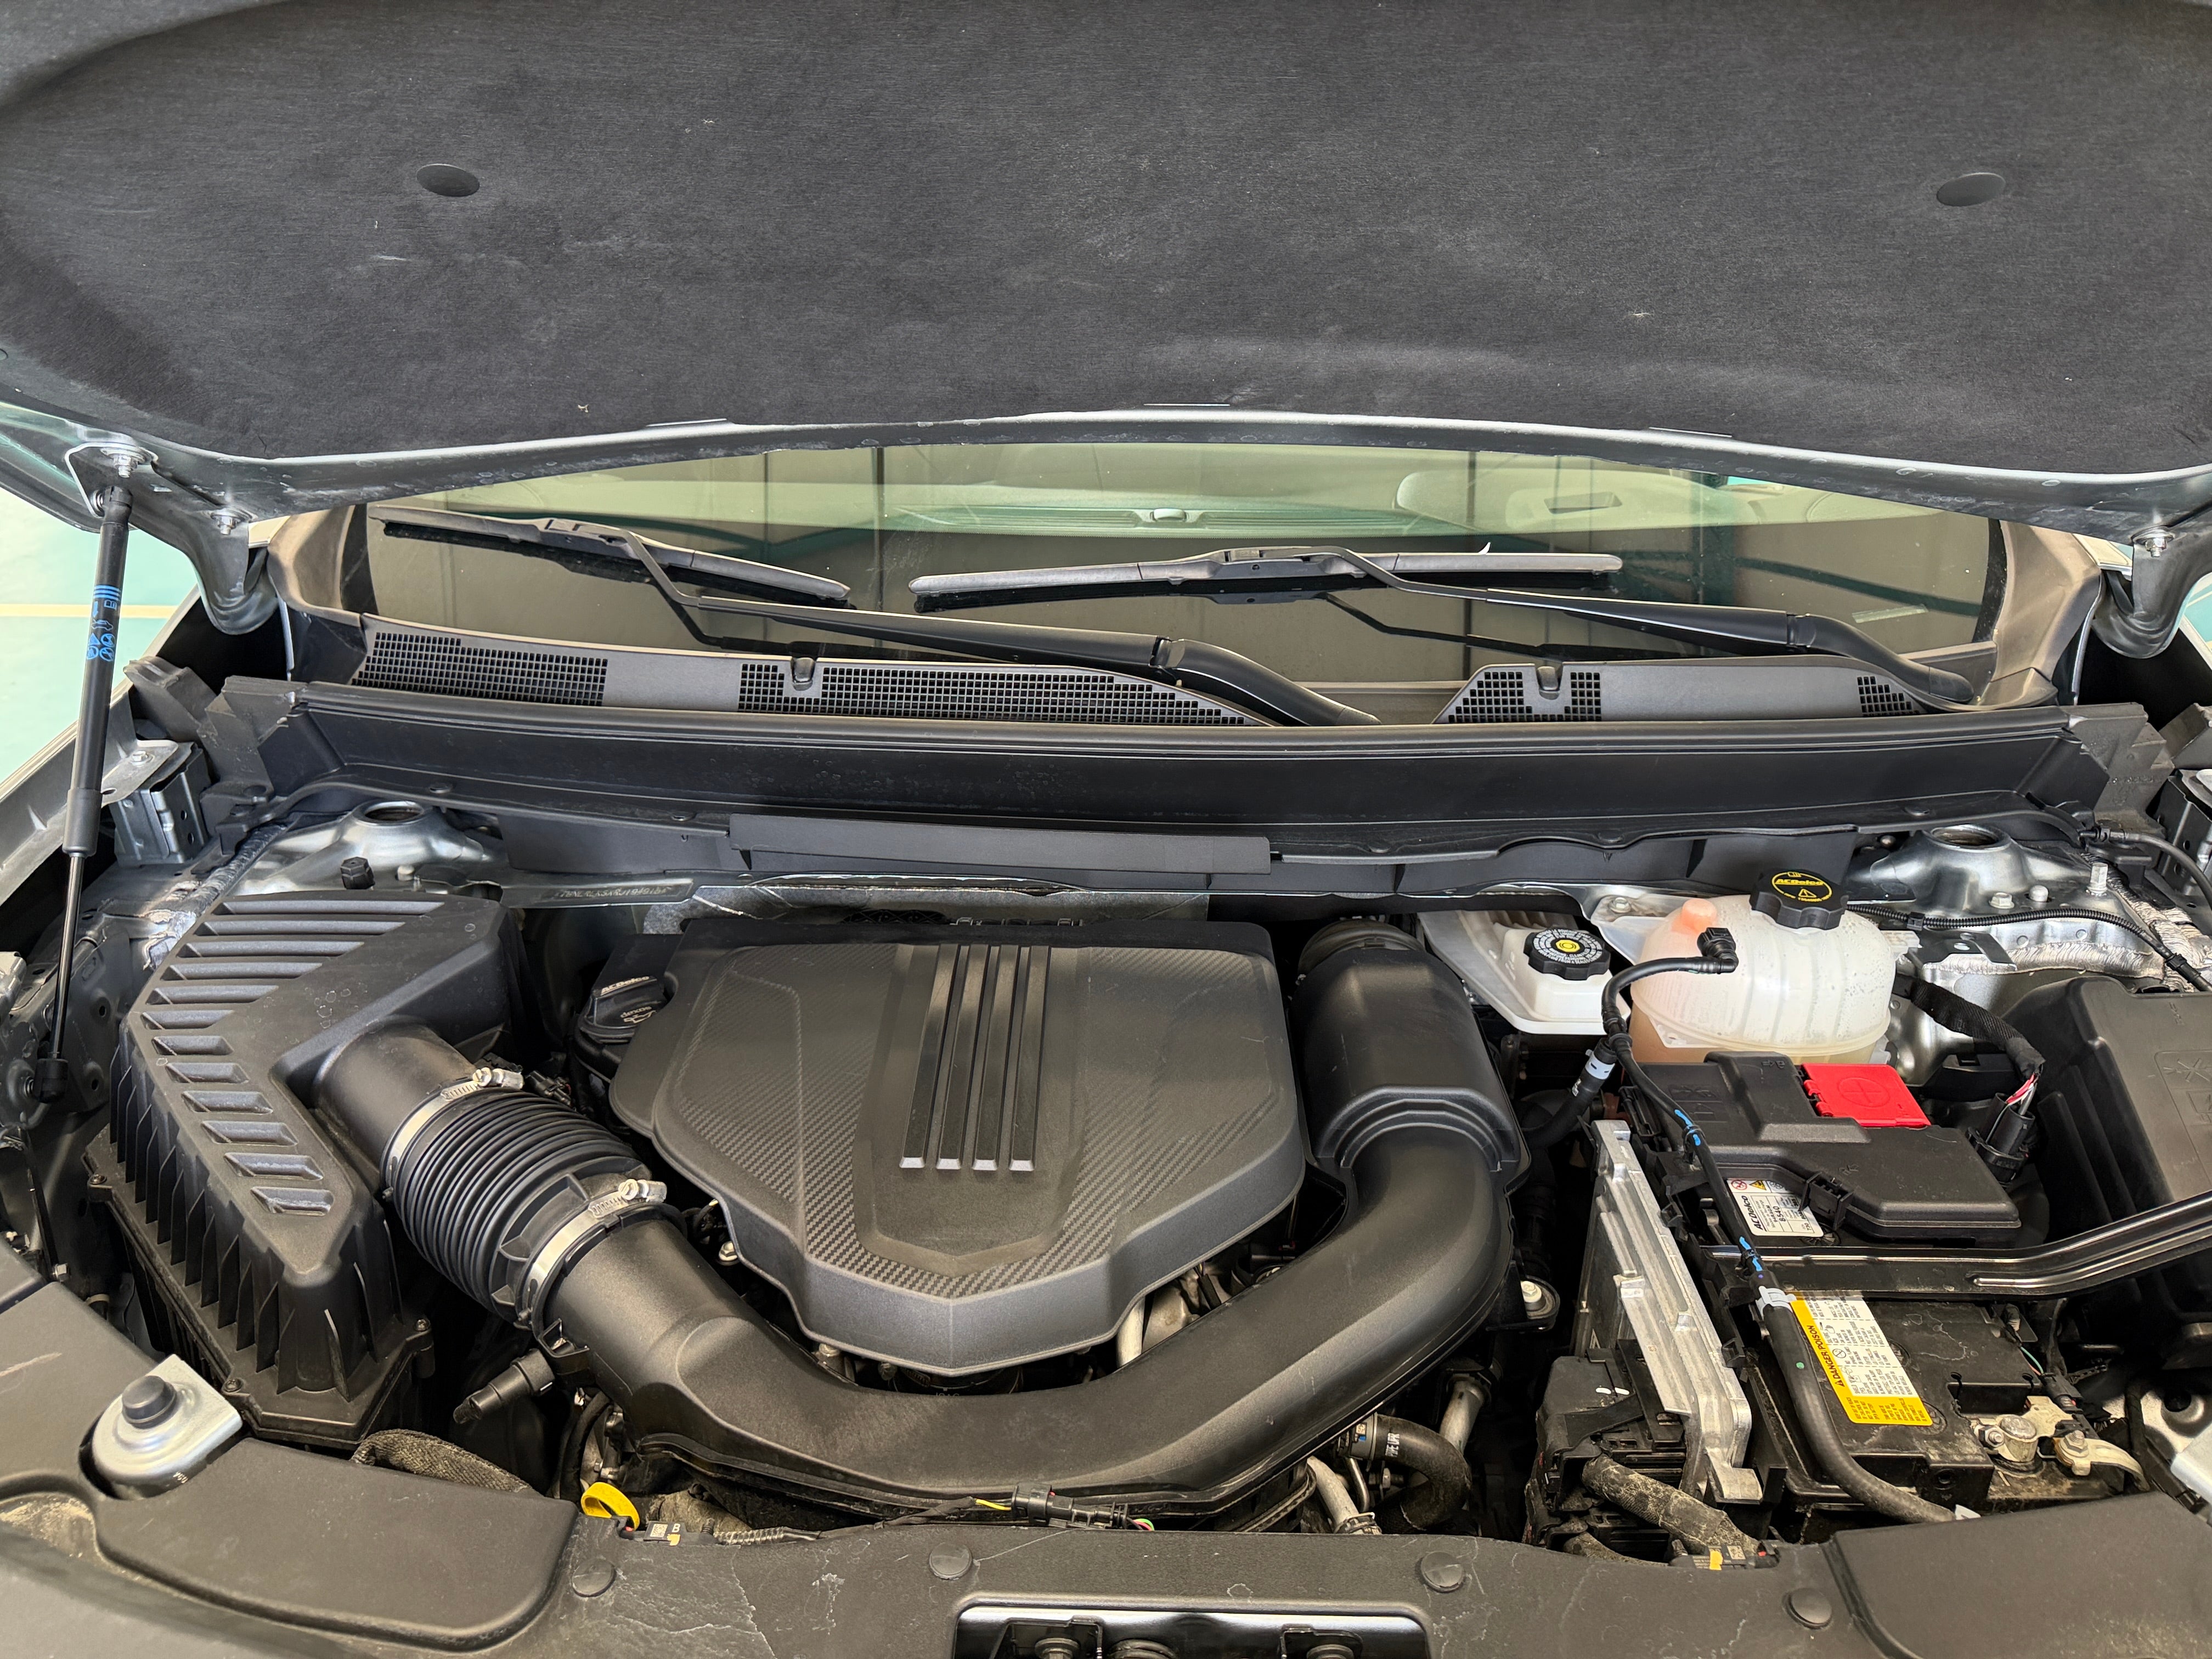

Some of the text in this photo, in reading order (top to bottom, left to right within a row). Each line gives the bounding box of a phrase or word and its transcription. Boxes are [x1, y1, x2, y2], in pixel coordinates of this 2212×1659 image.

[601, 976, 650, 995] ACDelco
[620, 1006, 652, 1018] dexos
[1741, 1195, 1763, 1231] ACDelco
[1773, 1206, 1786, 1222] 8540
[1807, 1325, 1841, 1379] DANGER/POISON
[672, 1523, 681, 1533] B
